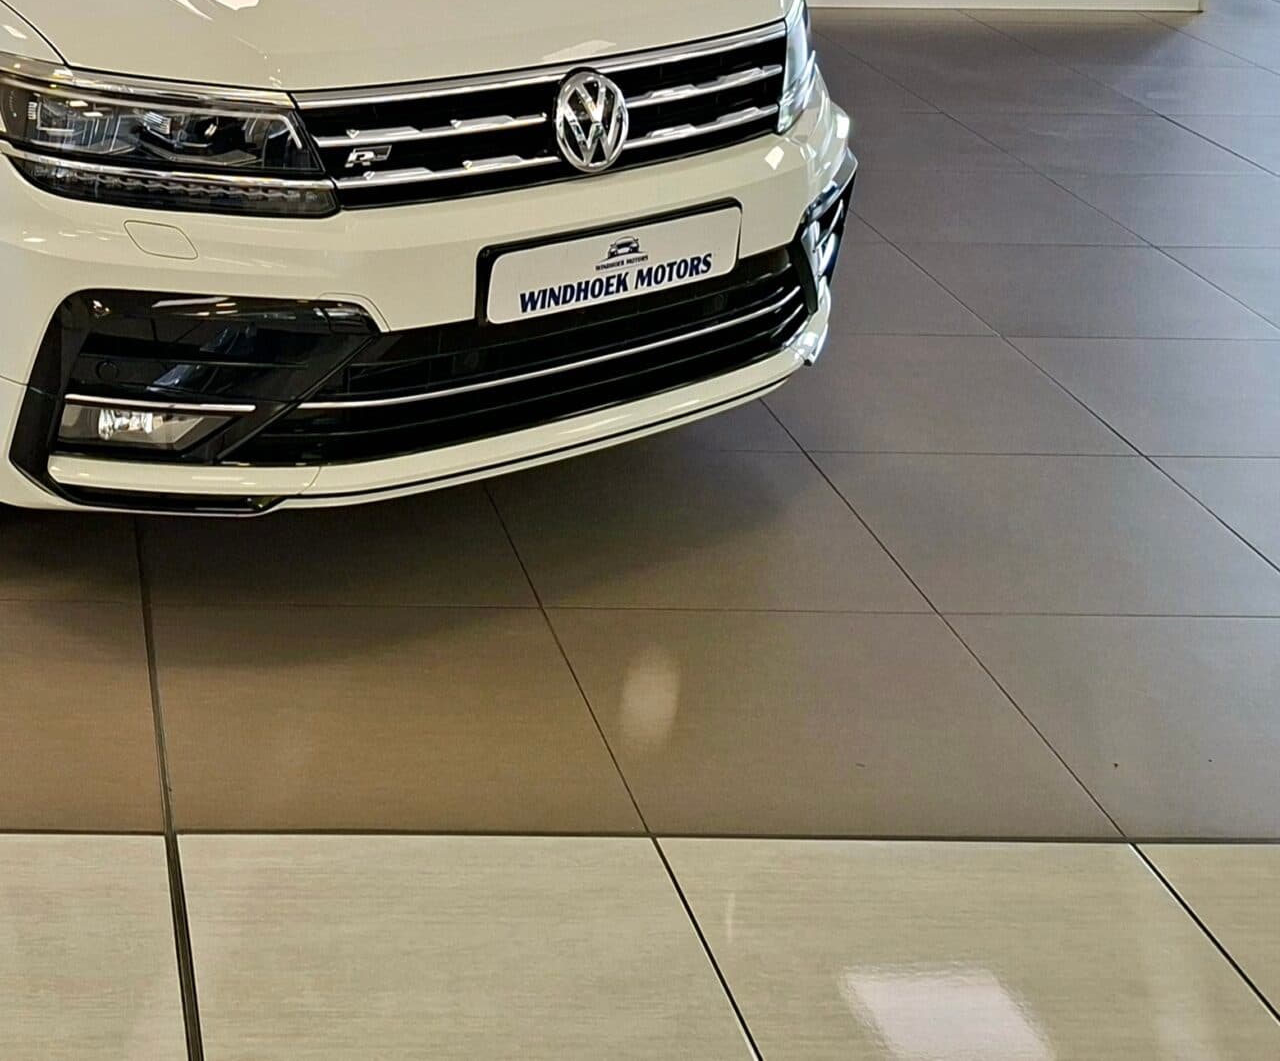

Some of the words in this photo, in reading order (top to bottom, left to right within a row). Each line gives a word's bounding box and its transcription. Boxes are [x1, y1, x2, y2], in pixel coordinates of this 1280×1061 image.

[558, 71, 627, 171] VW
[519, 272, 629, 313] WINDHOEK
[634, 253, 712, 289] MOTORS
